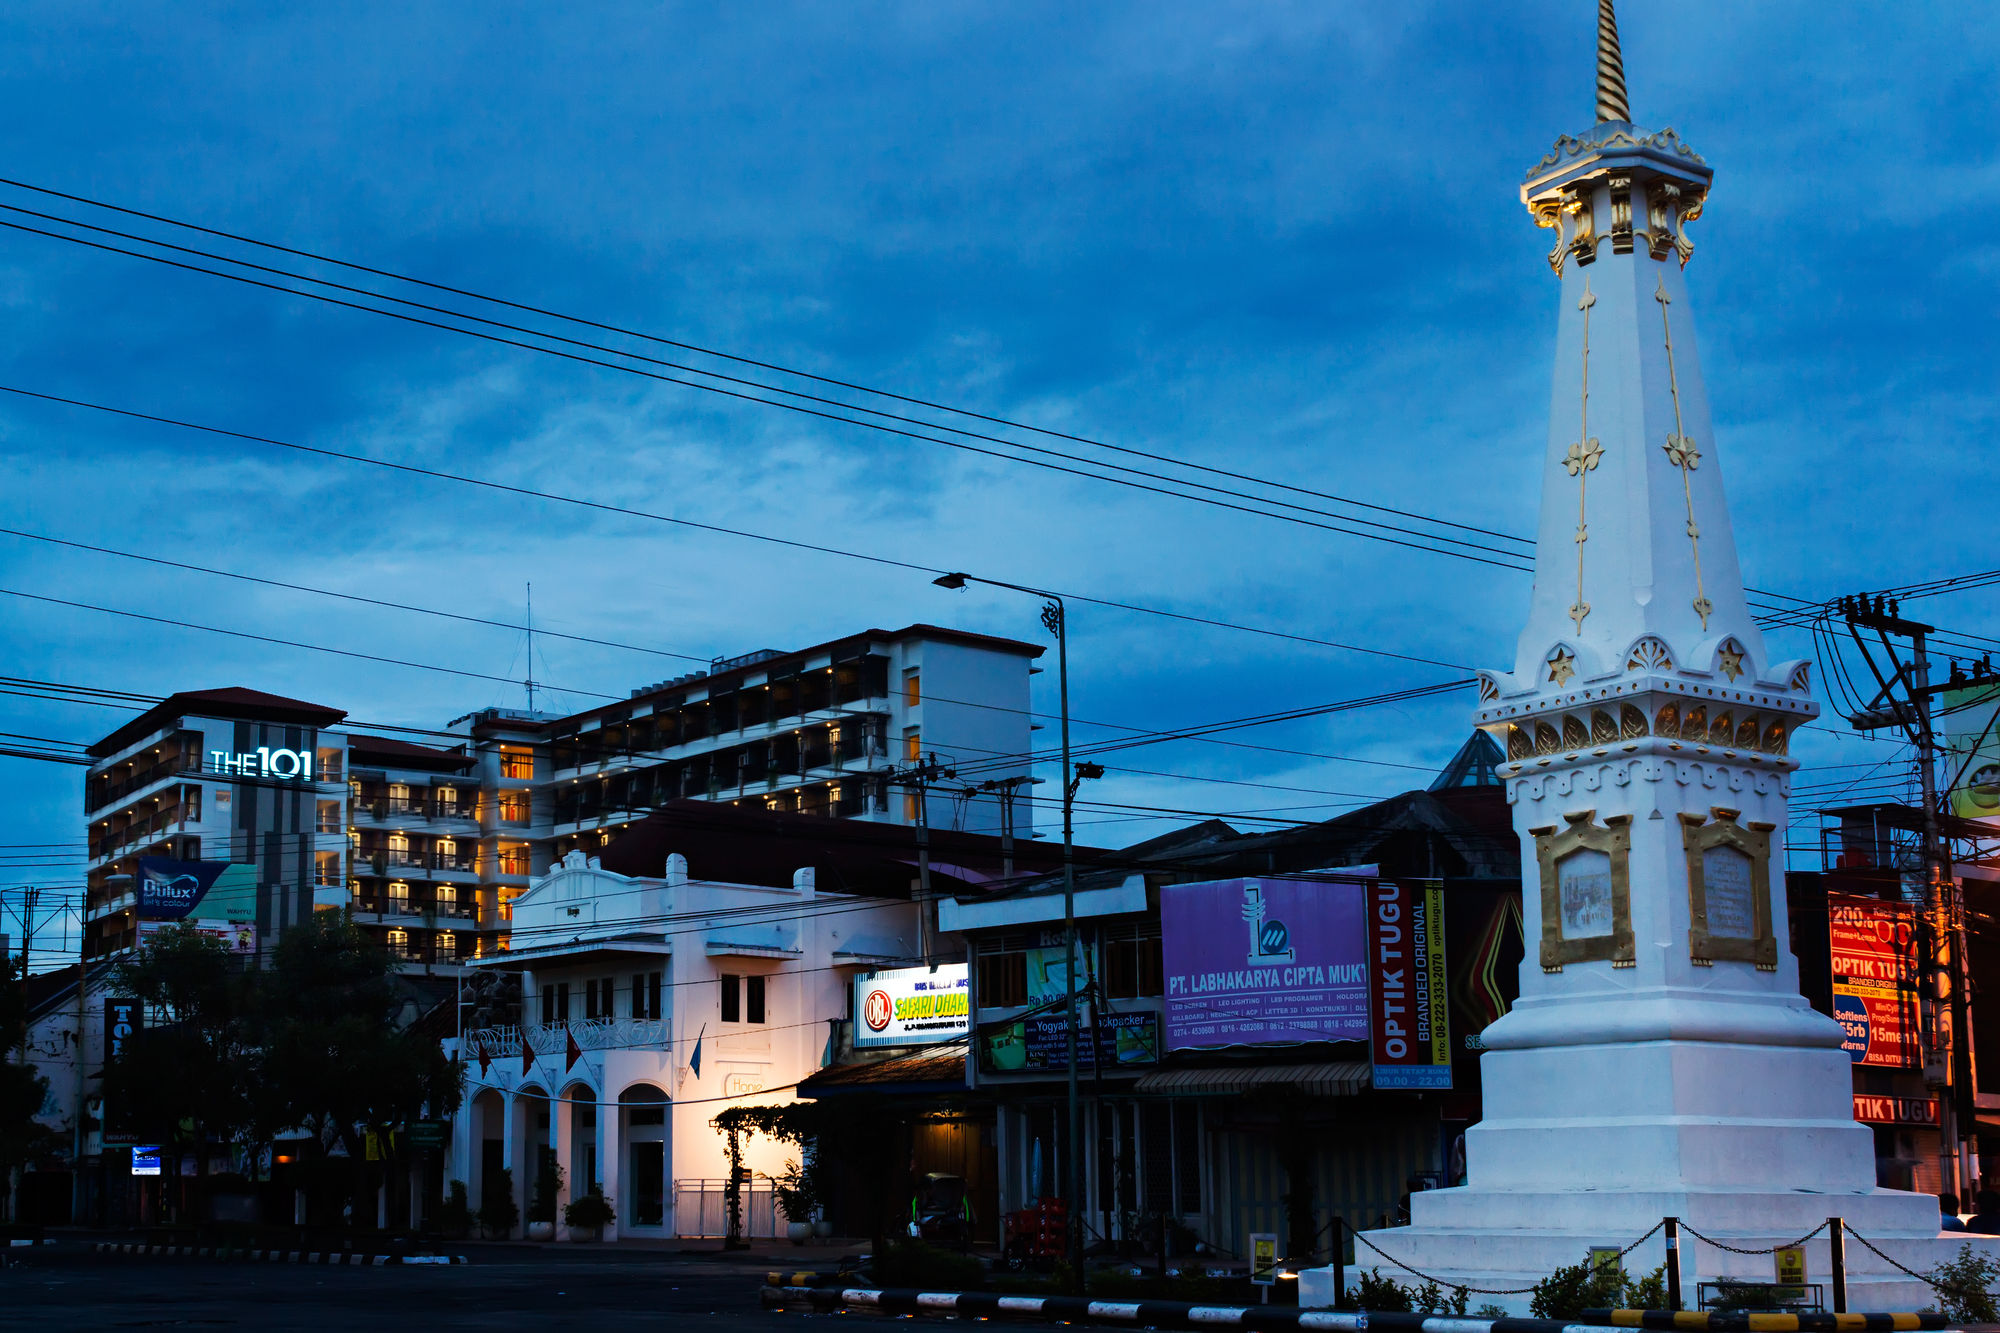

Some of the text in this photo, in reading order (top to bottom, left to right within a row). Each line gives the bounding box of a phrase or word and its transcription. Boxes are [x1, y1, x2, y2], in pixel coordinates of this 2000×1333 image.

[211, 747, 312, 781] THE 101
[143, 879, 192, 898] Dulux
[1378, 882, 1408, 1059] OPTIK TUGU
[1412, 901, 1430, 1042] BRANDED ORIGINAL
[1832, 956, 1875, 977] OPTIK
[1169, 975, 1188, 995] PT.
[1191, 968, 1281, 993] LABHAKARYA
[1283, 966, 1325, 989] CIPTA
[1847, 976, 1875, 986] BRANDED
[894, 995, 935, 1021] SAFARI
[1029, 995, 1041, 1008] Rp
[1231, 998, 1260, 1006] LIGHTING
[1172, 1013, 1205, 1022] BILLBOARD
[1835, 1009, 1868, 1023] Softlens
[1464, 1034, 1488, 1050] SE
[1868, 1052, 1885, 1063] BISA
[1376, 1076, 1408, 1086] 09.00
[1418, 1076, 1451, 1086] 22.00
[1886, 1099, 1935, 1122] TUGU
